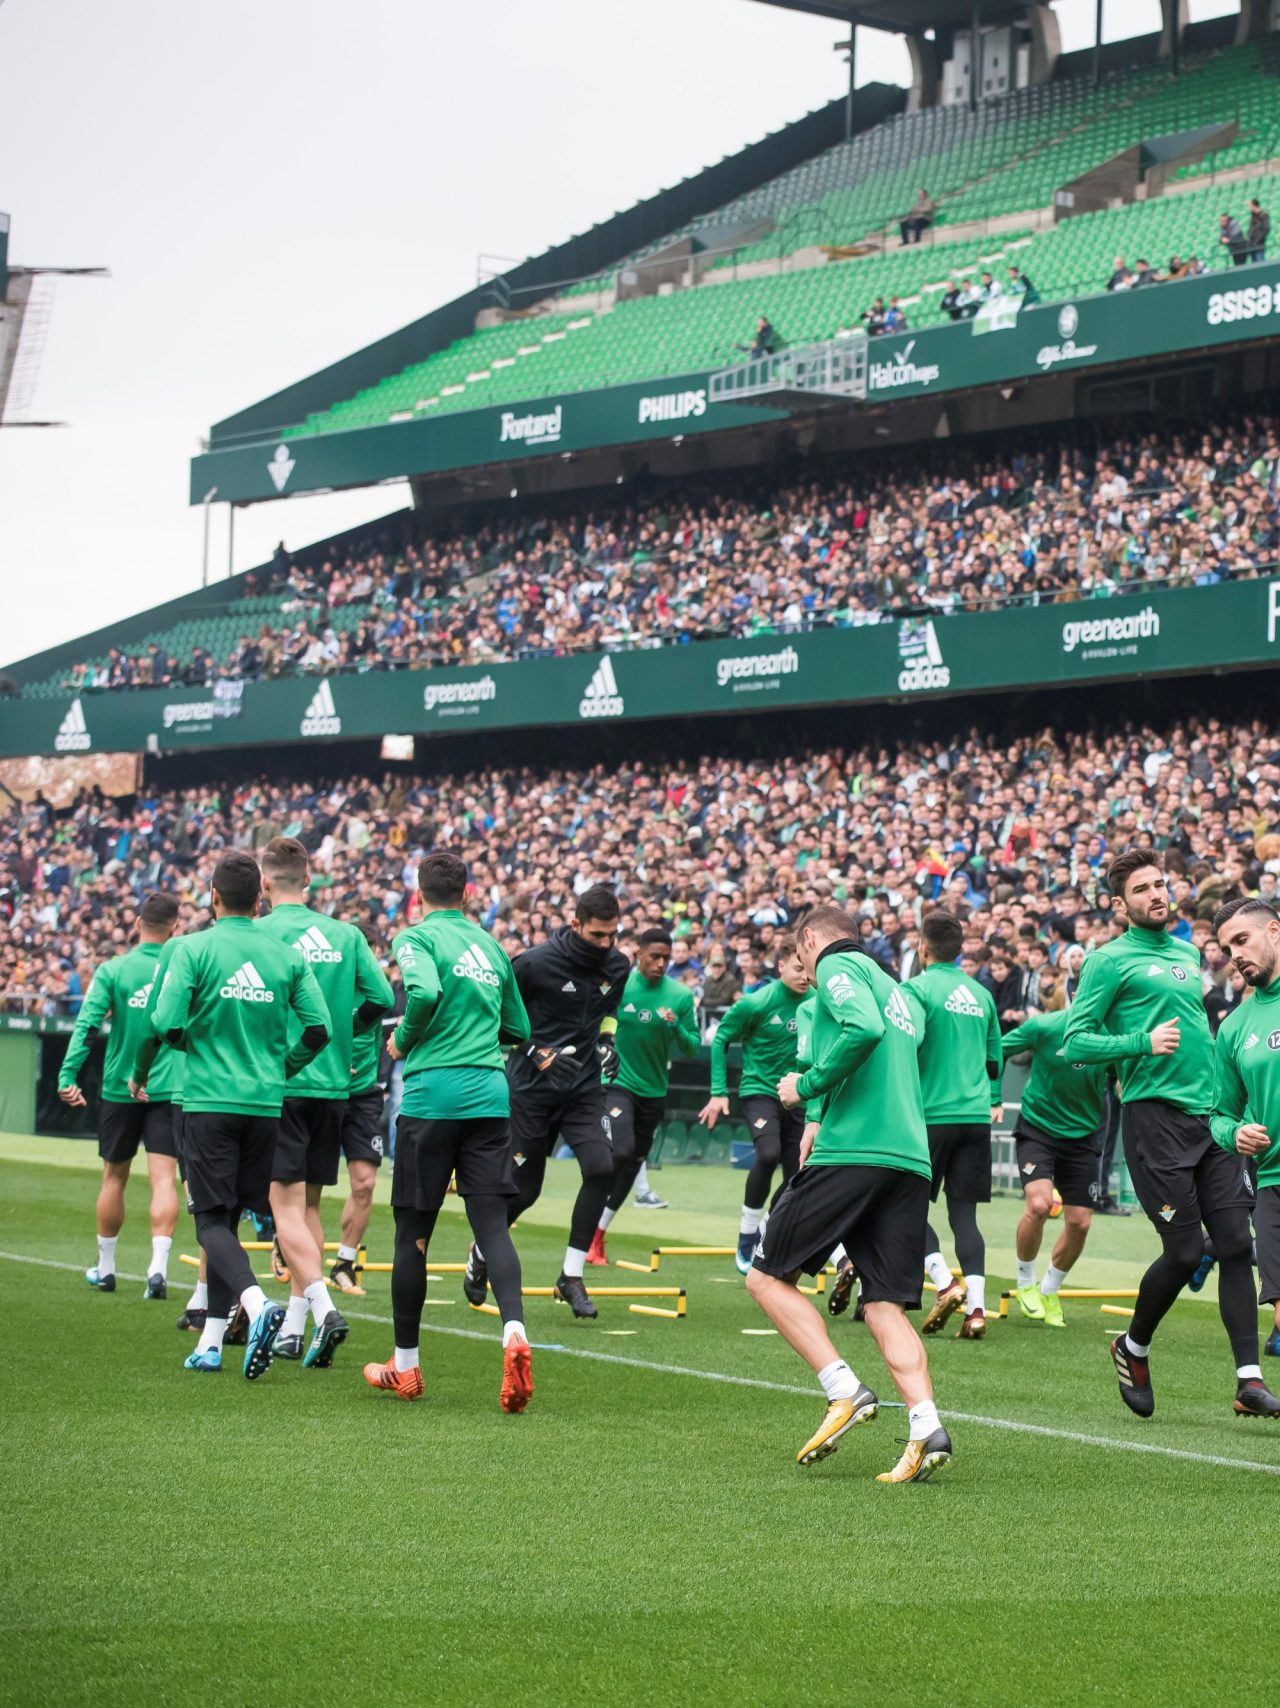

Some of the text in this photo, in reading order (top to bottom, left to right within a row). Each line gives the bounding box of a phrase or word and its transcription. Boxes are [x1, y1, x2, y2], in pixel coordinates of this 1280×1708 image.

[639, 391, 706, 424] PHILIPS
[1063, 606, 1160, 652] greenearth
[717, 645, 799, 686] greenearth
[898, 666, 951, 692] adidas
[424, 675, 496, 710] greenearth
[579, 696, 624, 719] adidas
[300, 716, 342, 737] adidas
[1172, 967, 1186, 980] 19
[220, 985, 275, 1003] adidas
[944, 1001, 985, 1018] adidas
